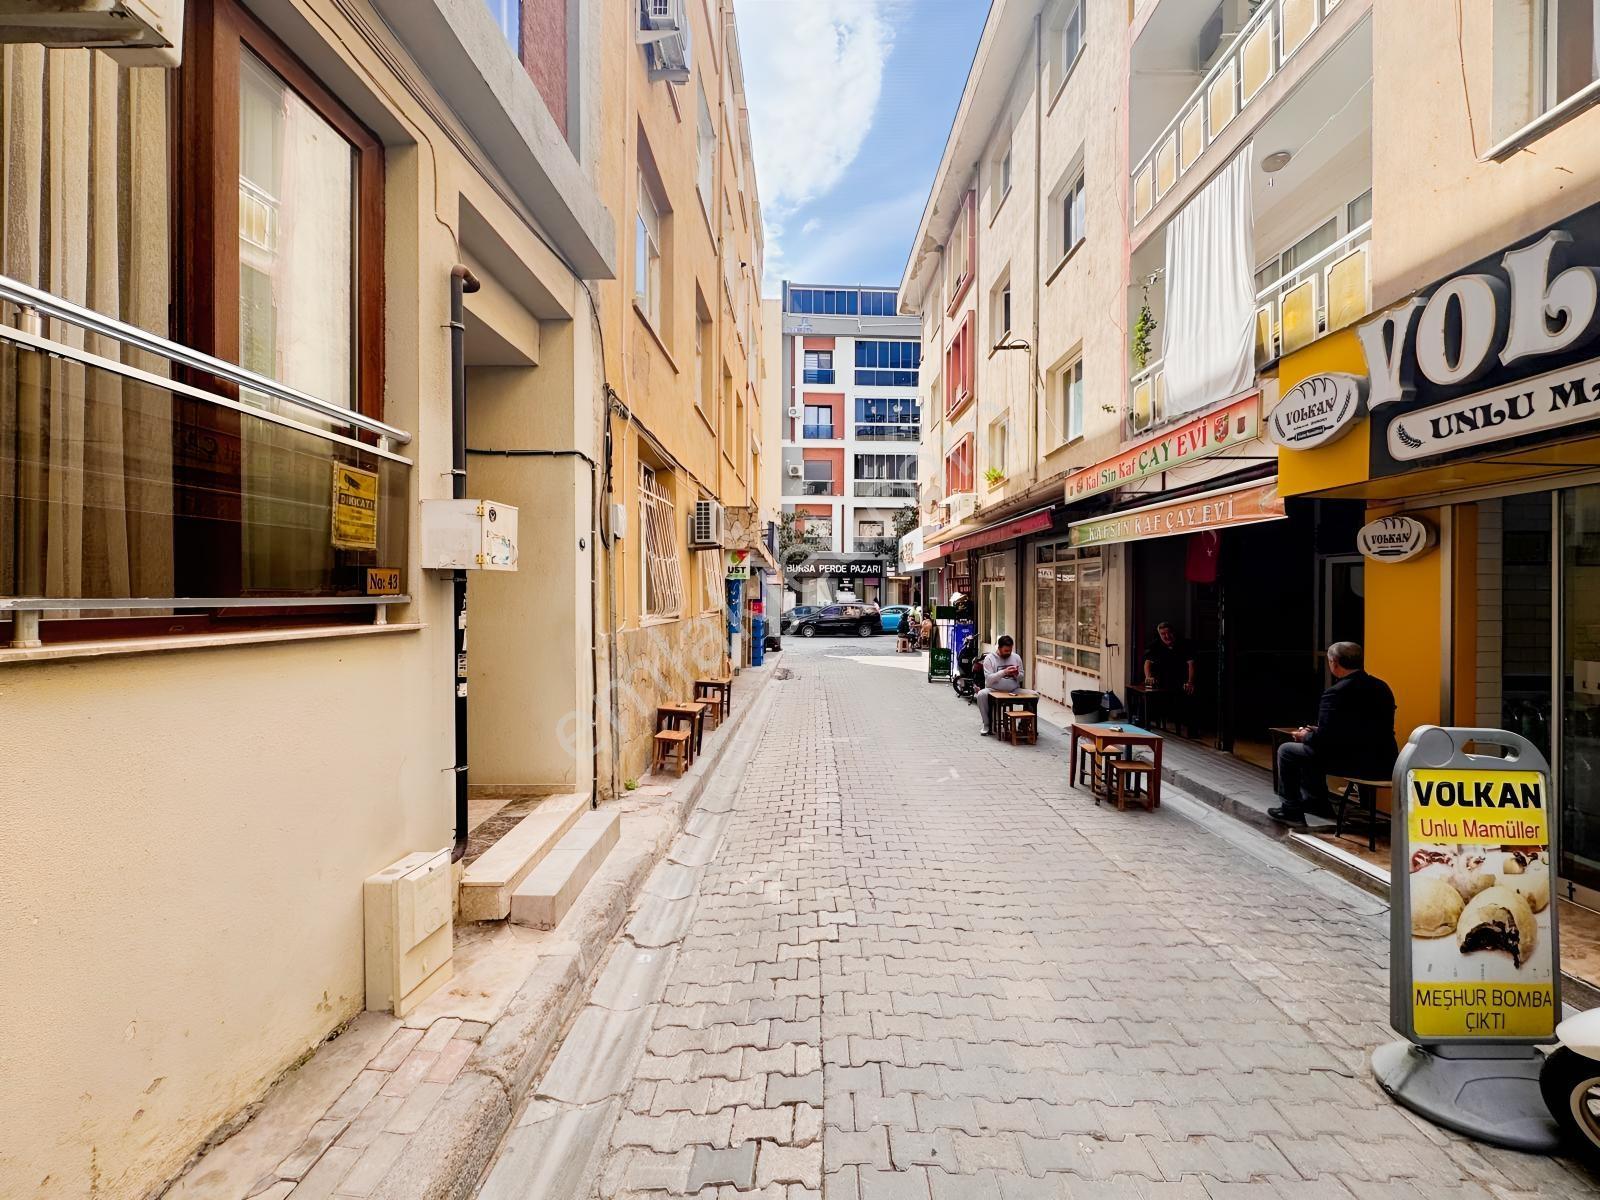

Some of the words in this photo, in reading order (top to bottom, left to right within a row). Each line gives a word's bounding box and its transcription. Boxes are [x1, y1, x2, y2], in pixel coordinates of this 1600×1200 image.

[1285, 397, 1334, 426] VOLKAN
[1430, 391, 1535, 440] UNLU
[1118, 458, 1136, 479] Kaf
[1138, 438, 1172, 475] ÇAY
[1176, 419, 1208, 457] EVİ
[1166, 507, 1196, 533] ÇAY
[1202, 494, 1233, 523] EVİ
[1371, 532, 1410, 545] VOLKAN
[786, 564, 816, 573] BURSA
[818, 564, 847, 573] PERDE
[850, 564, 881, 574] PAZARI
[369, 573, 386, 590] No:
[388, 574, 398, 590] 43
[1413, 780, 1542, 809] VOLKAN
[1420, 818, 1458, 837] Unlu
[1462, 819, 1540, 839] Mamüller
[1416, 989, 1486, 1011] MEŞHUR
[1492, 990, 1552, 1008] BOMBA
[1465, 1012, 1505, 1033] ÇIKTI
